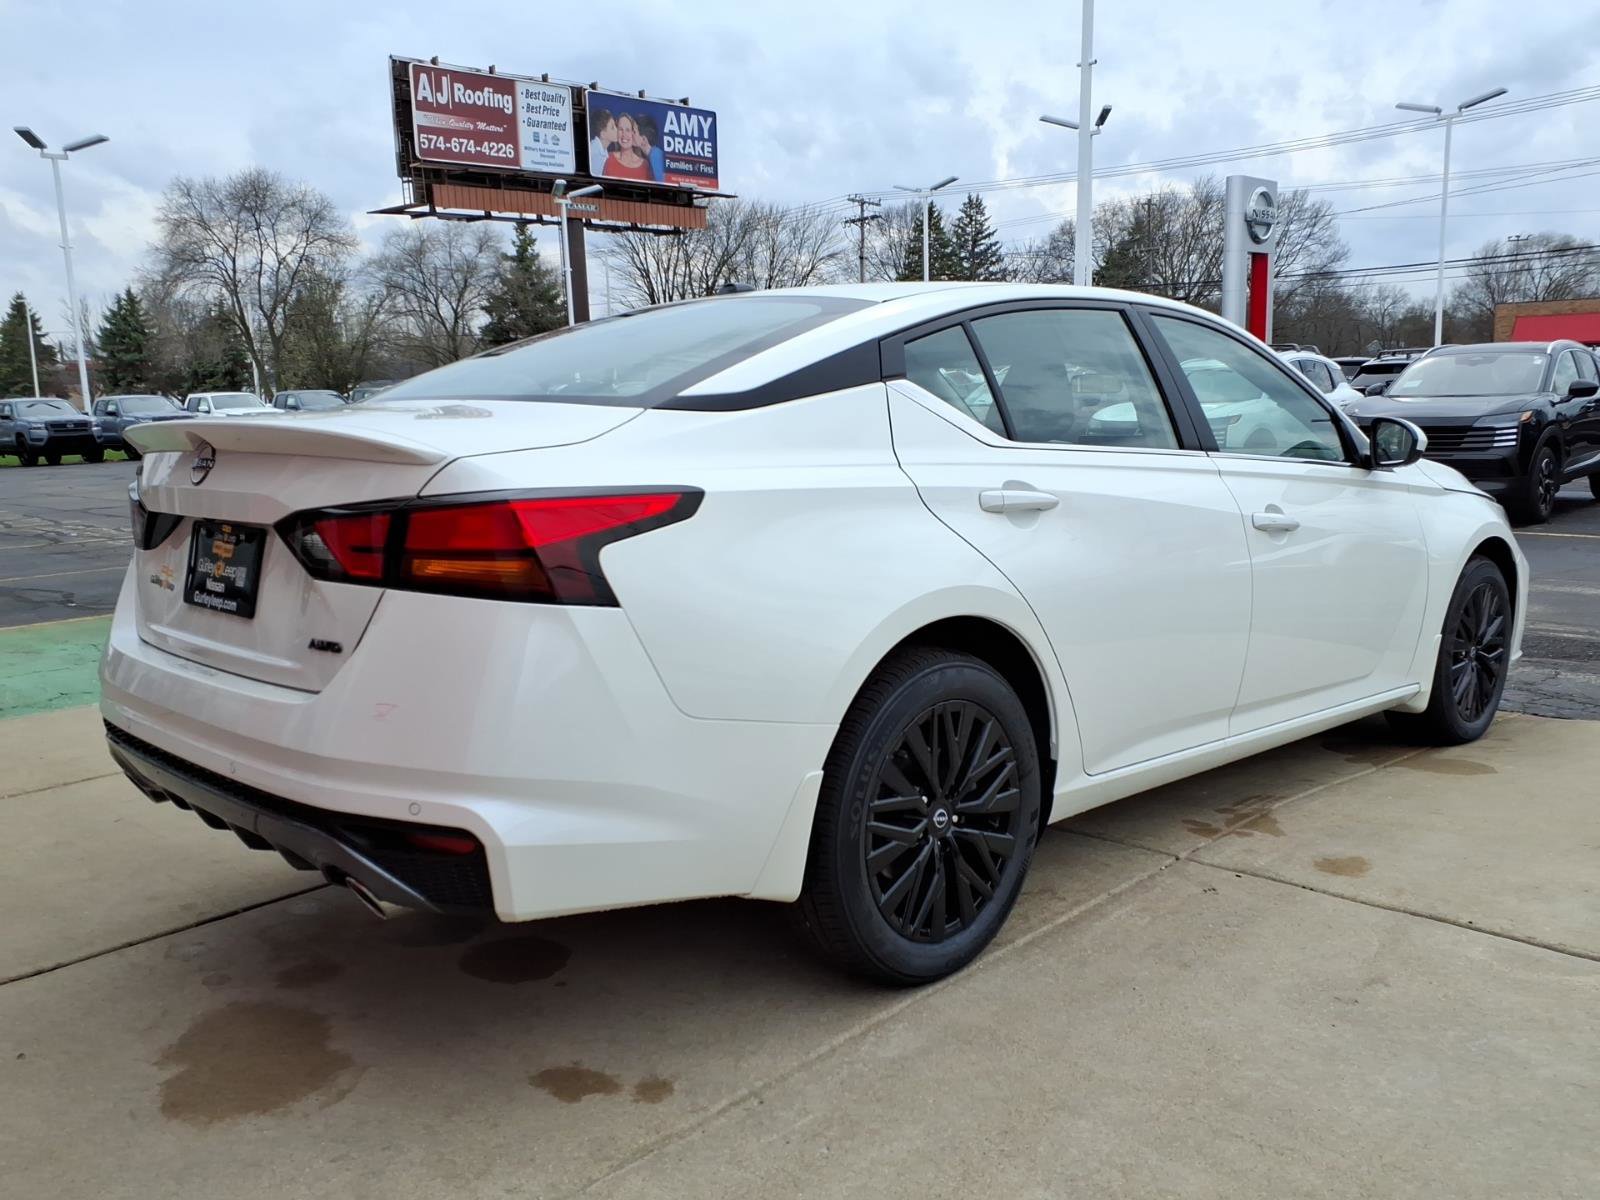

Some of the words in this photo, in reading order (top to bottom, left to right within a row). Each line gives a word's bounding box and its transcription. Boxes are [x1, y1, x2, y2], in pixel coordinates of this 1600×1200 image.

[453, 82, 513, 114] Roofing
[525, 88, 540, 101] Best
[541, 91, 566, 106] Quality
[526, 103, 541, 115] Best
[542, 104, 560, 117] Price
[526, 117, 567, 132] Guaranteed
[663, 110, 713, 139] AMY
[419, 133, 515, 158] 574-674-4226
[663, 135, 713, 158] DRAKE
[665, 159, 693, 171] Families
[700, 164, 714, 174] First
